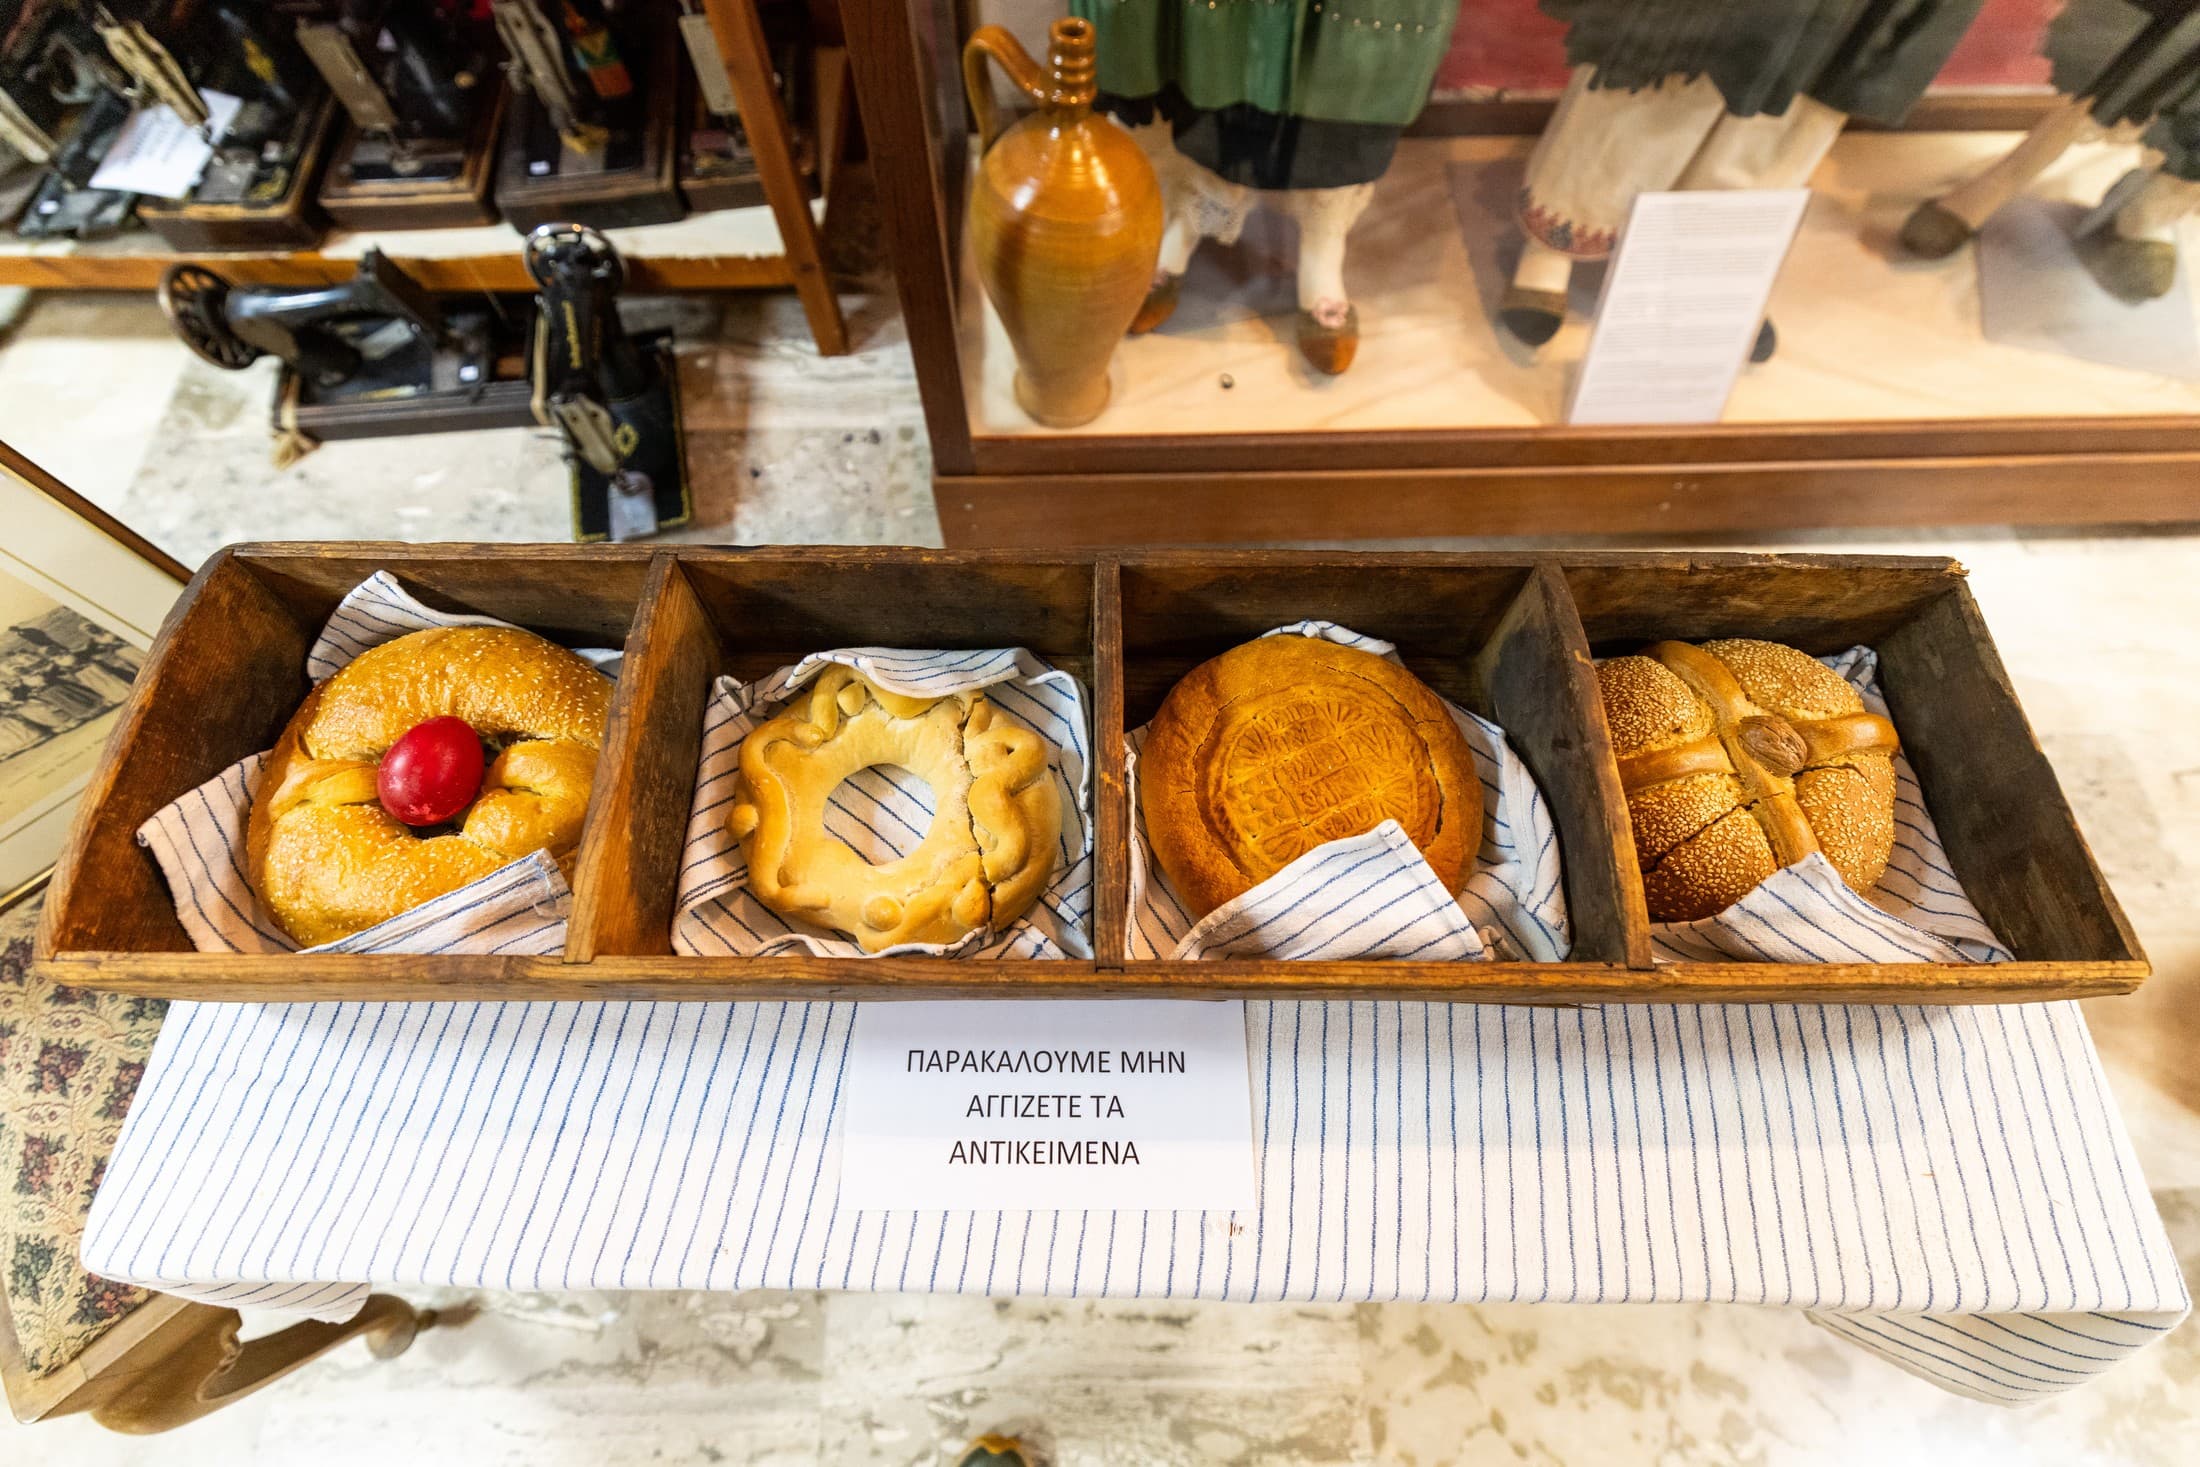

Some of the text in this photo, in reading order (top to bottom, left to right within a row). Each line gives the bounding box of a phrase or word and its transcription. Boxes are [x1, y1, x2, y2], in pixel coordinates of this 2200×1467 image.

[907, 1049, 1185, 1074] ΠΑΡΑΚΑΛΟΥΜΕ ΜΗΝ
[966, 1094, 1125, 1119] ΑΓΓΙΖΕΤΕ ΤΑ
[948, 1140, 1140, 1165] ΑΝΤΙΚΕΙΜΕΝΑ
